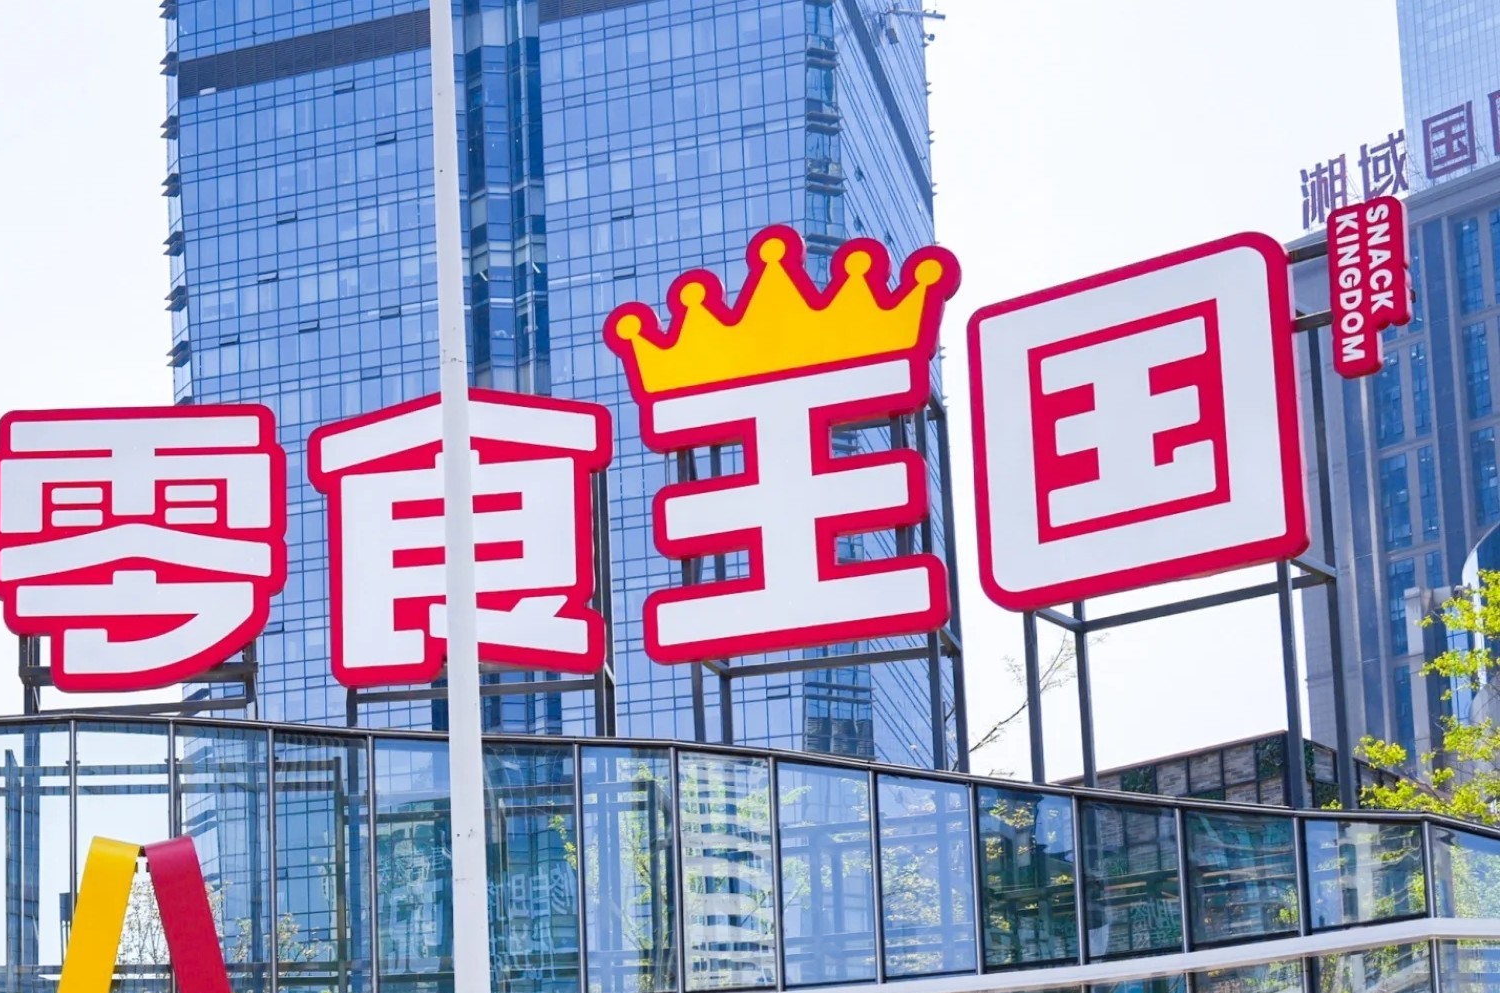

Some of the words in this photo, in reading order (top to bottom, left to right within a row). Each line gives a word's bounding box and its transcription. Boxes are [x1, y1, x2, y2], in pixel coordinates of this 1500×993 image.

[1300, 90, 1500, 230] 湘域国
[1336, 211, 1365, 363] KINGDOM
[1366, 203, 1394, 314] SNACK
